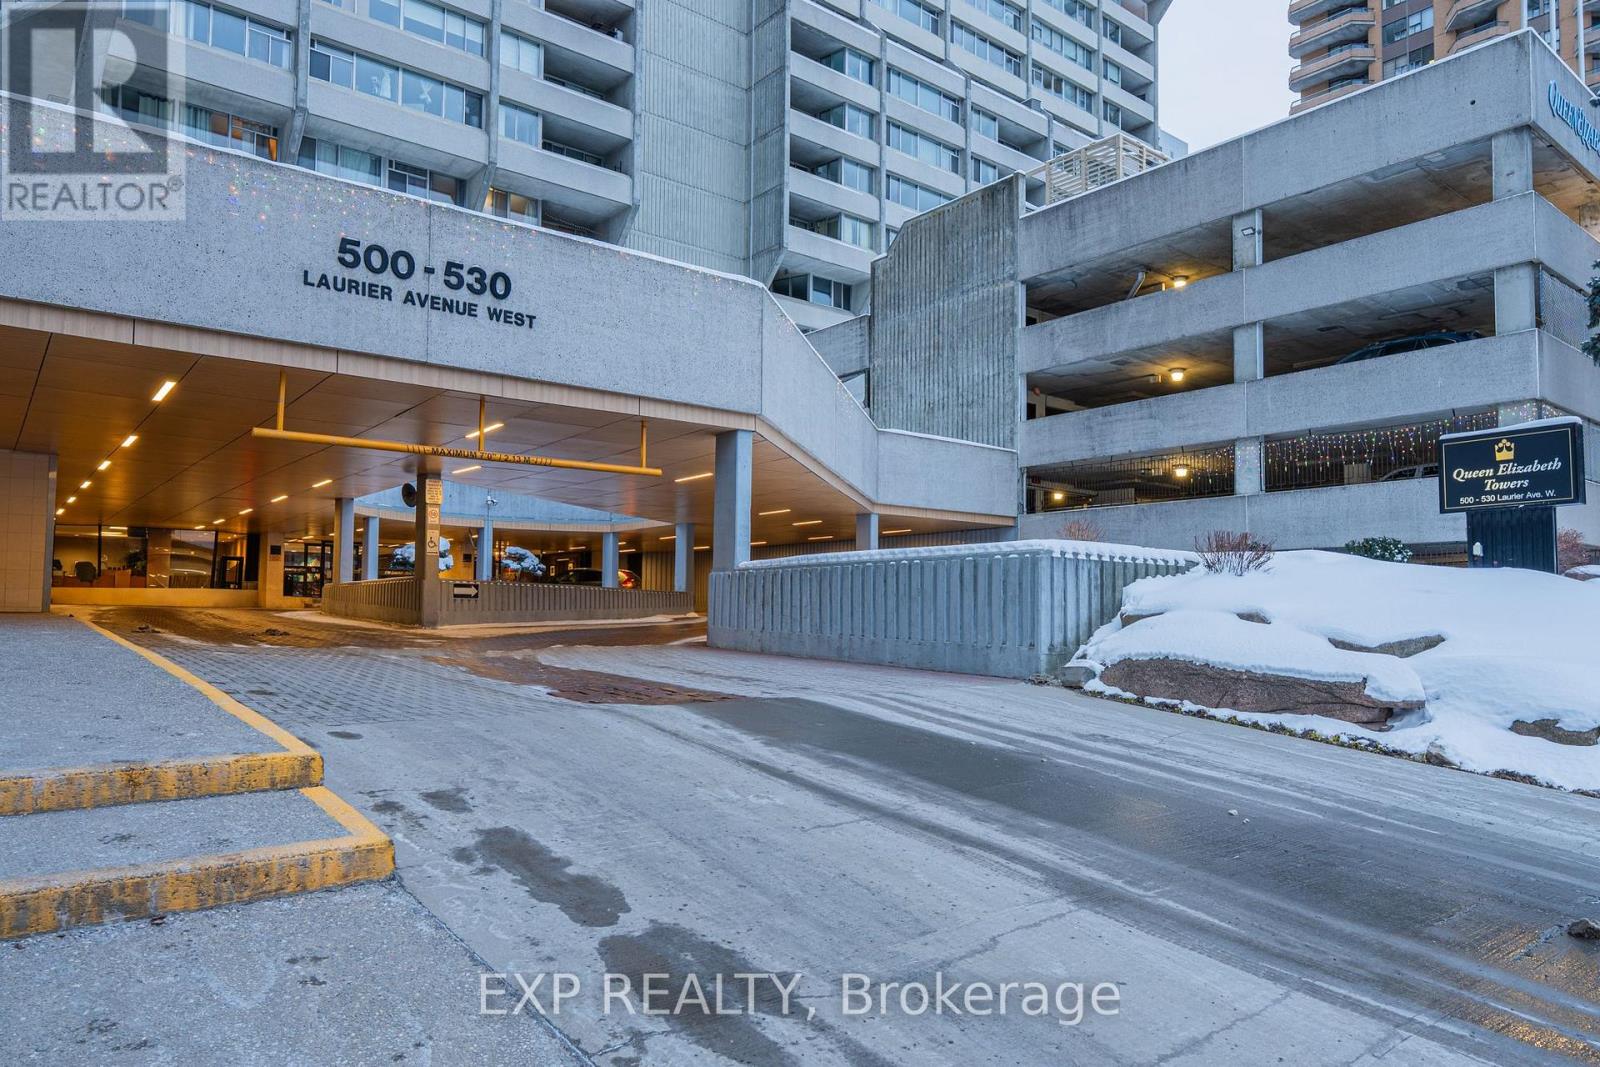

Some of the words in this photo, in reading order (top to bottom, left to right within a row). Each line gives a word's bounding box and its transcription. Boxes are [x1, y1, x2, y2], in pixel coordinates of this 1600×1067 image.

[337, 237, 415, 280] 500
[443, 260, 512, 300] 530
[303, 269, 393, 301] LAURIER
[403, 290, 478, 318] AVENUE
[487, 306, 537, 329] WEST
[431, 447, 477, 459] MAXIMUM
[1453, 467, 1494, 481] Queen
[1497, 457, 1562, 476] Elizabeth
[1484, 479, 1530, 491] Towers
[1459, 496, 1474, 505] 500
[1481, 494, 1495, 503] 530
[1497, 492, 1524, 502] Laurier
[1526, 491, 1543, 500] Ave.
[1545, 489, 1556, 498] W.
